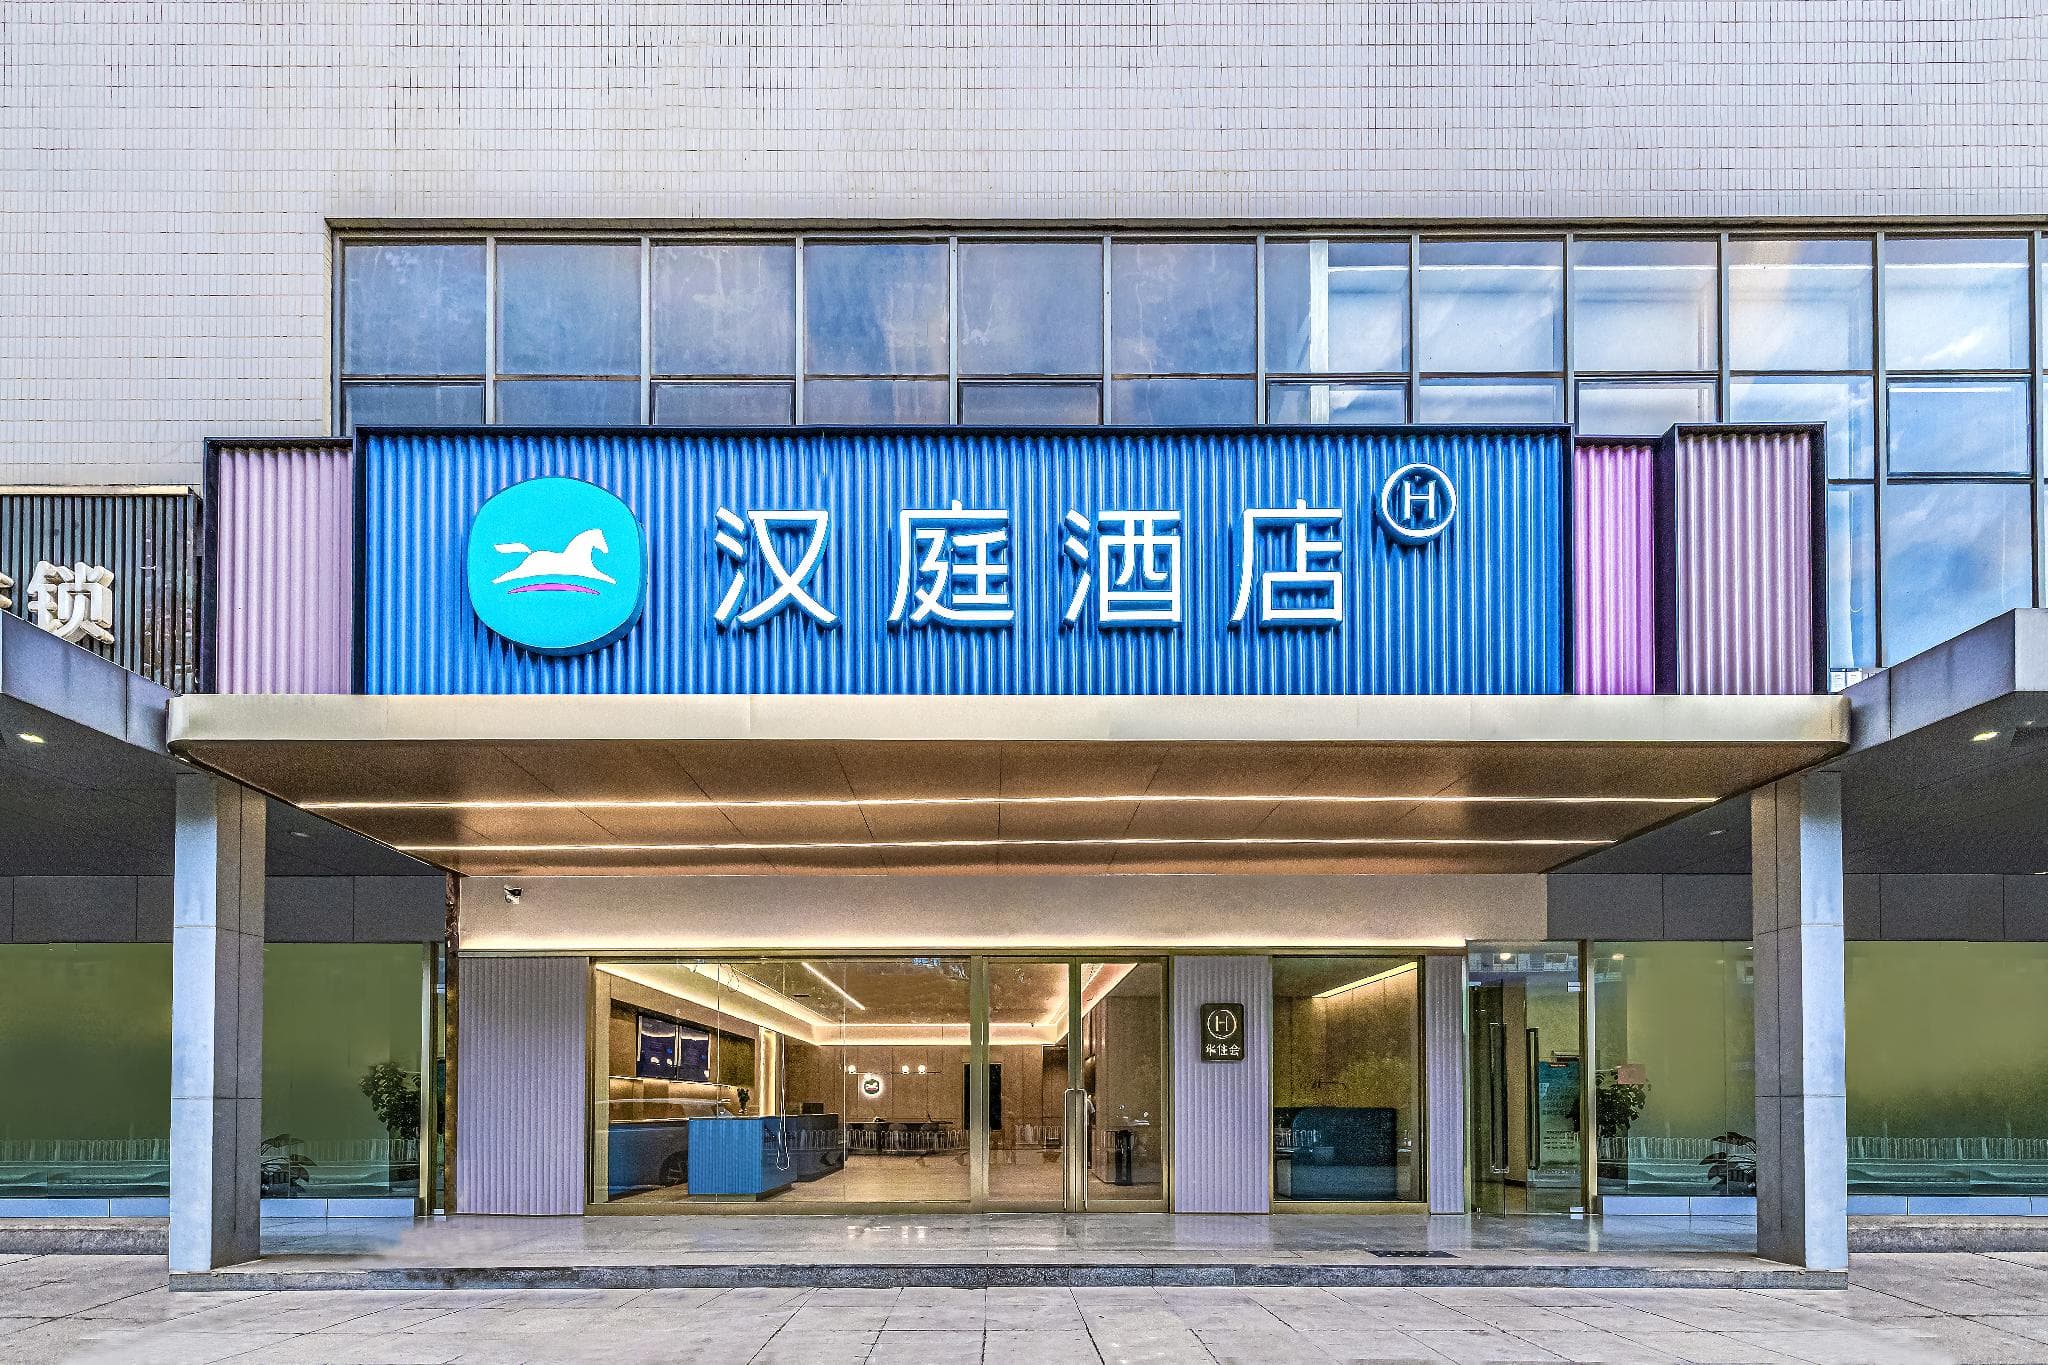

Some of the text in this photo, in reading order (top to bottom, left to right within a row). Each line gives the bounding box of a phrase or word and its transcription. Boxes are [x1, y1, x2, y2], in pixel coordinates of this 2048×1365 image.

[0, 561, 115, 645] 锁
[713, 500, 1343, 628] 汉庭酒店
